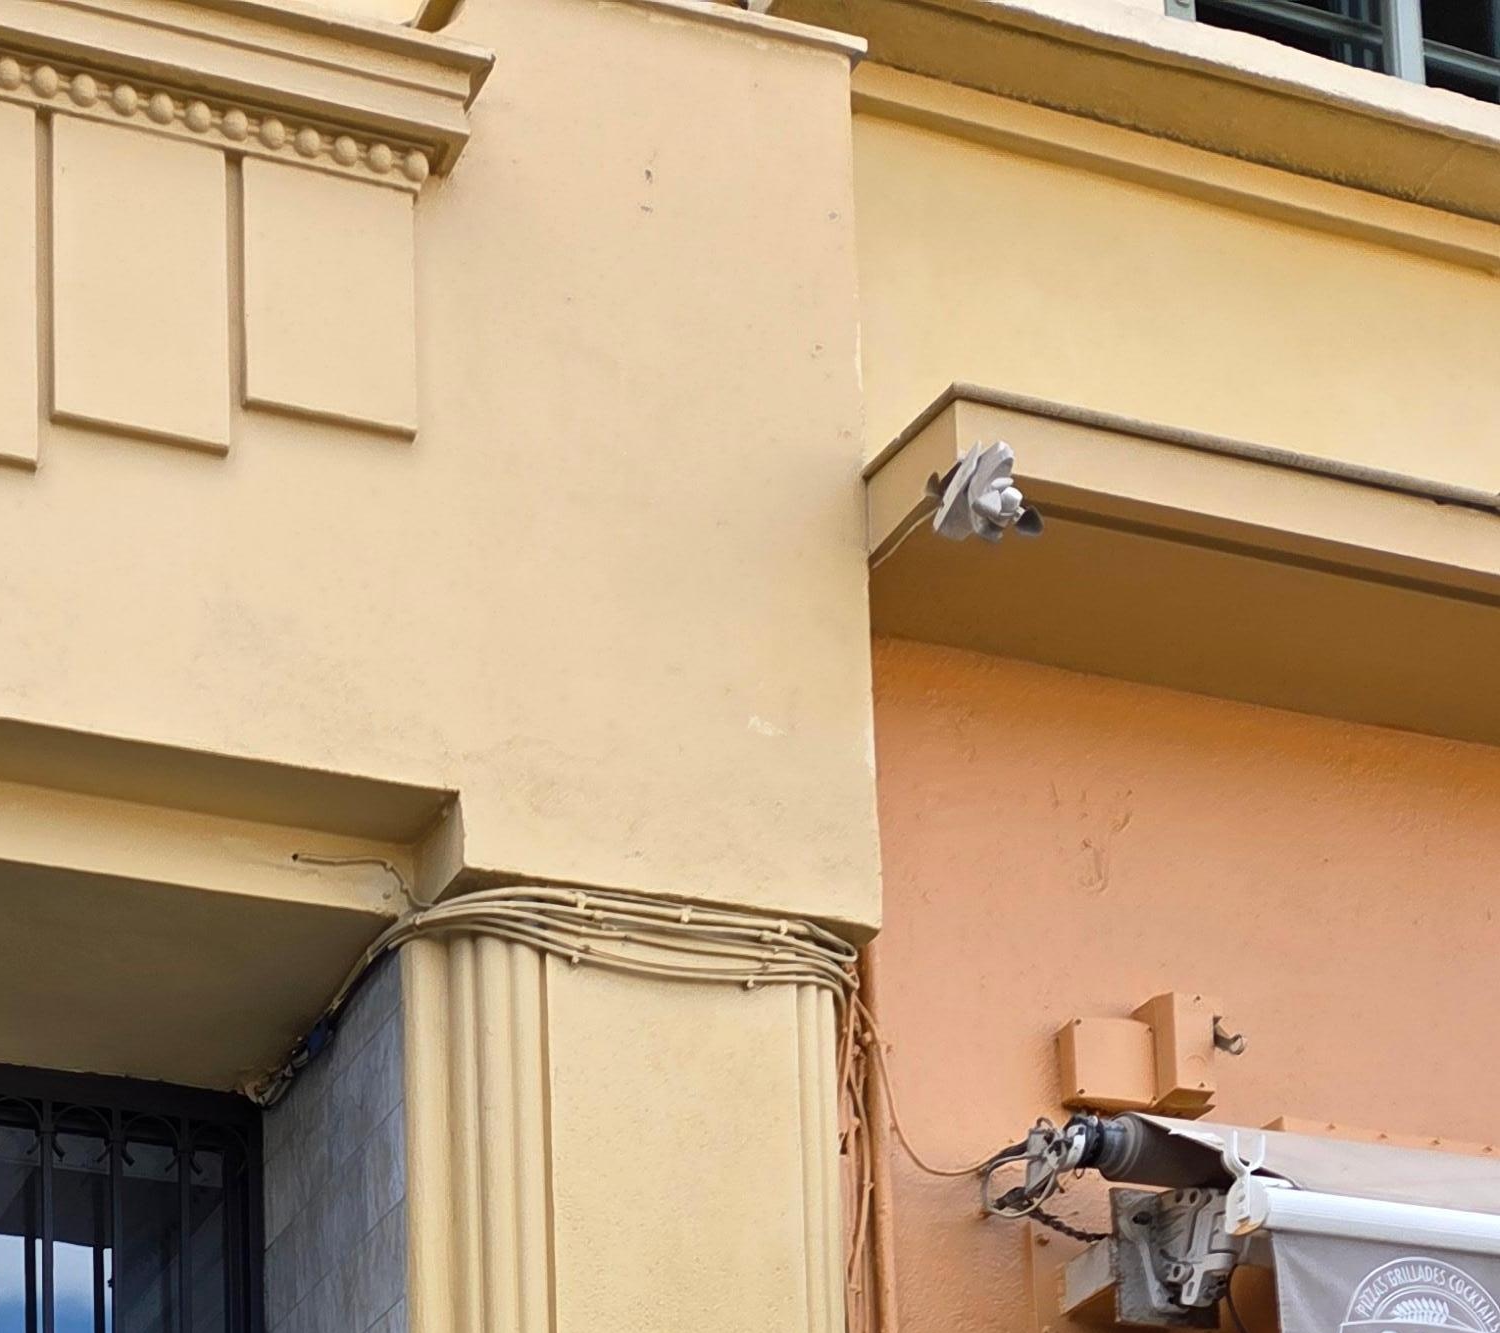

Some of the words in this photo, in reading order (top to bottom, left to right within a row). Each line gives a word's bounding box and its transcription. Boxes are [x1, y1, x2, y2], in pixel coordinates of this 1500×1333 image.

[1355, 1276, 1388, 1317] PIZZAS
[1387, 1265, 1446, 1287] GRILLADES
[1449, 1274, 1500, 1333] COCKTAILS
